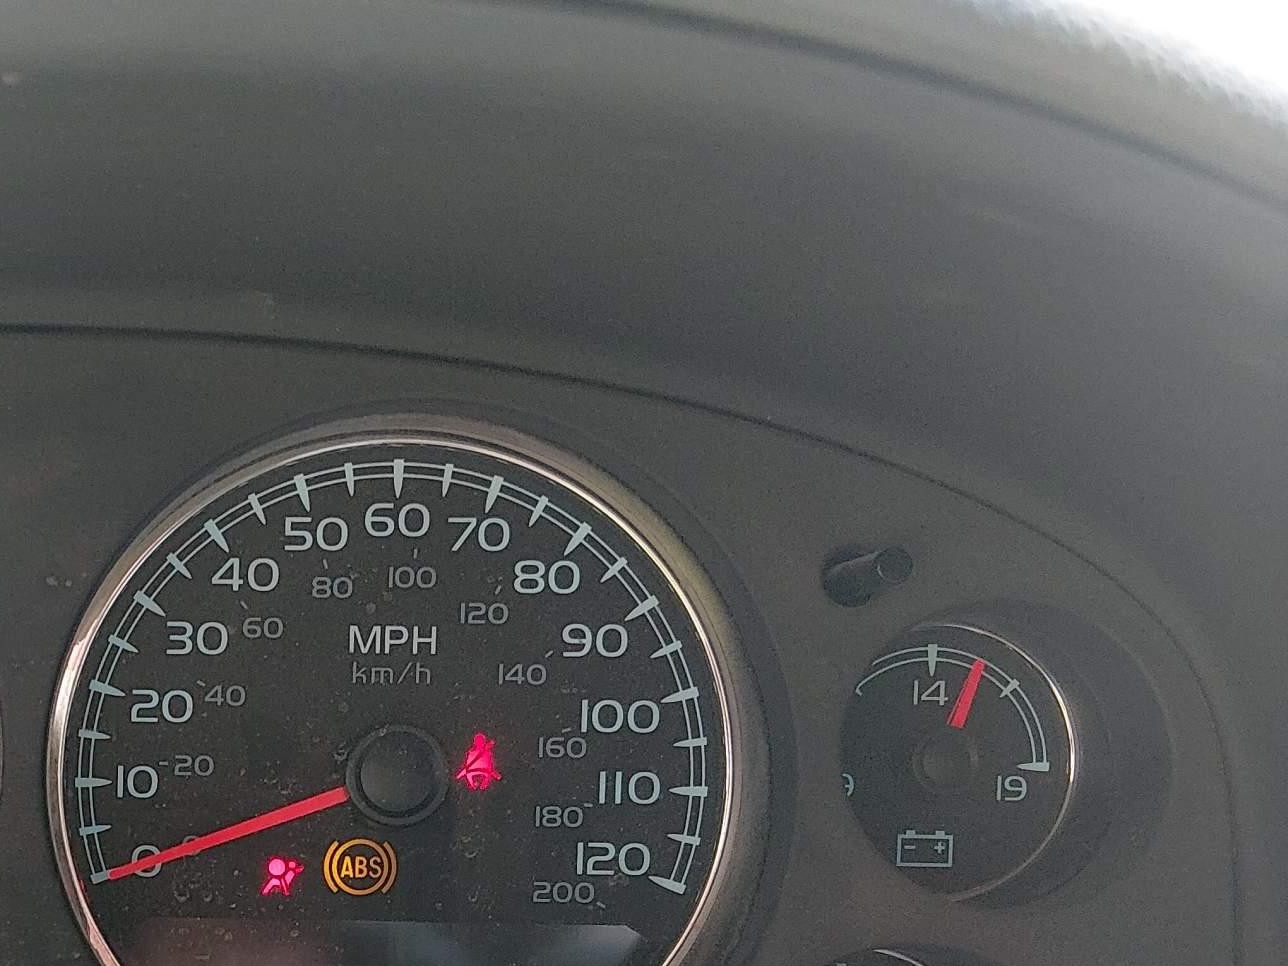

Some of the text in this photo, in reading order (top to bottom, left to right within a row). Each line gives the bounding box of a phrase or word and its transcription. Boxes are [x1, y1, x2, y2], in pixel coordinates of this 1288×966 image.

[284, 517, 348, 552] 50
[364, 503, 432, 538] 60
[447, 517, 511, 552] 70
[212, 558, 279, 593] 40
[312, 577, 353, 600] 80
[387, 566, 437, 589] 100
[513, 560, 581, 595] 80
[460, 603, 509, 625] 120
[165, 621, 228, 656] 30
[242, 617, 284, 640] 60
[348, 625, 438, 655] MPH
[561, 623, 628, 658] 90
[352, 662, 432, 686] km/h
[498, 664, 547, 686] 140
[204, 685, 247, 706] 40
[913, 679, 948, 705] 14
[130, 689, 194, 724] 20
[580, 699, 660, 735] 100
[537, 737, 587, 759] 160
[174, 755, 215, 777] 20
[116, 765, 159, 798] 10
[597, 772, 661, 805] 110
[996, 775, 1028, 801] 19
[535, 805, 584, 828] 180
[132, 844, 162, 878] 0
[340, 856, 383, 878] ABS
[575, 842, 651, 876] 120
[532, 881, 596, 903] 200
